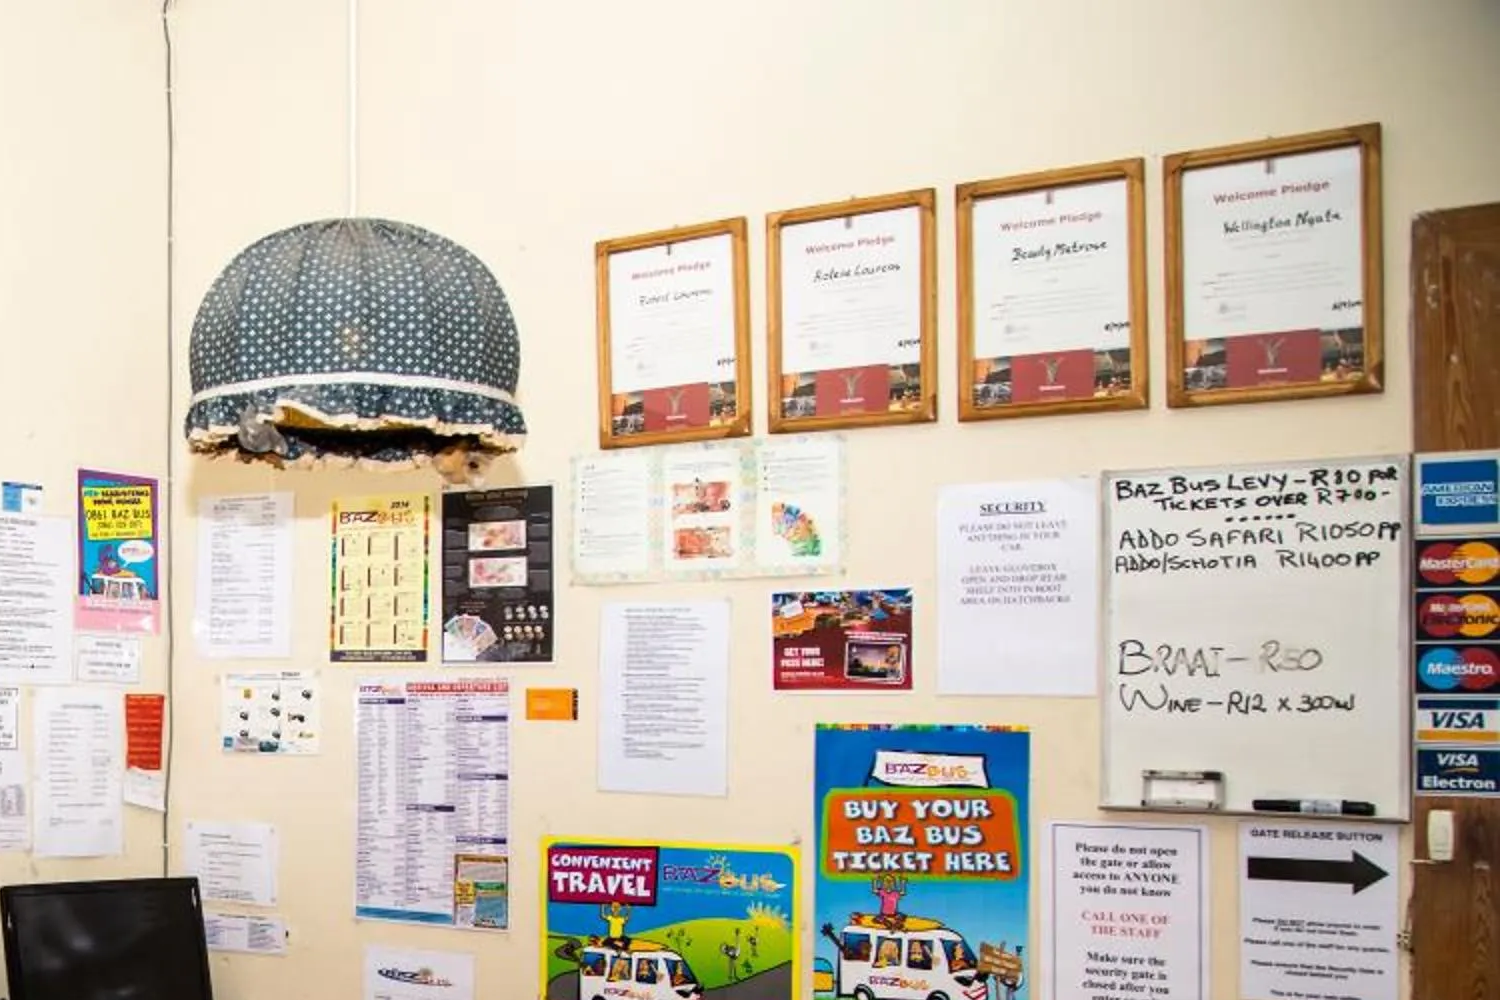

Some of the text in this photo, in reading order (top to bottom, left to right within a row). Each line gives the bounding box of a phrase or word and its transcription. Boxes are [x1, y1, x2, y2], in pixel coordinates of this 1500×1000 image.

[1213, 181, 1330, 205] Welcome Pledge
[1000, 211, 1102, 231] Welcome Pledge
[1115, 479, 1164, 500] BAZ
[1227, 473, 1288, 492] LEVY
[979, 501, 1047, 515] SECURITY
[1255, 493, 1308, 507] OVER
[1119, 529, 1179, 551] ADDO
[1186, 528, 1284, 549] SAFARI
[1119, 639, 1225, 678] BRAAI
[1260, 640, 1323, 673] R50
[1426, 662, 1494, 676] Maestro
[1430, 711, 1486, 729] VISA
[1436, 753, 1480, 767] VISA
[1421, 775, 1496, 790] Electron
[843, 799, 993, 820] BUY YOUR
[856, 825, 983, 846] BAZ BUS
[1250, 829, 1383, 842] GATE RELEASE BUTTON
[1076, 842, 1177, 858] Please do not open
[550, 853, 653, 873] CONVENIENT
[833, 851, 1013, 873] TICKET HERE
[1080, 857, 1097, 867] the
[1100, 859, 1122, 869] gate
[1141, 859, 1171, 869] allow
[552, 871, 651, 898] TRAVEL
[1073, 872, 1179, 884] access to ANYONE
[1080, 885, 1171, 897] you do not know
[1081, 911, 1169, 925] CALL ONE OF
[1092, 925, 1161, 939] THE STAFF
[1087, 951, 1165, 967] Make sure the
[1085, 967, 1167, 980] security gate is
[1082, 979, 1169, 996] closed after you
